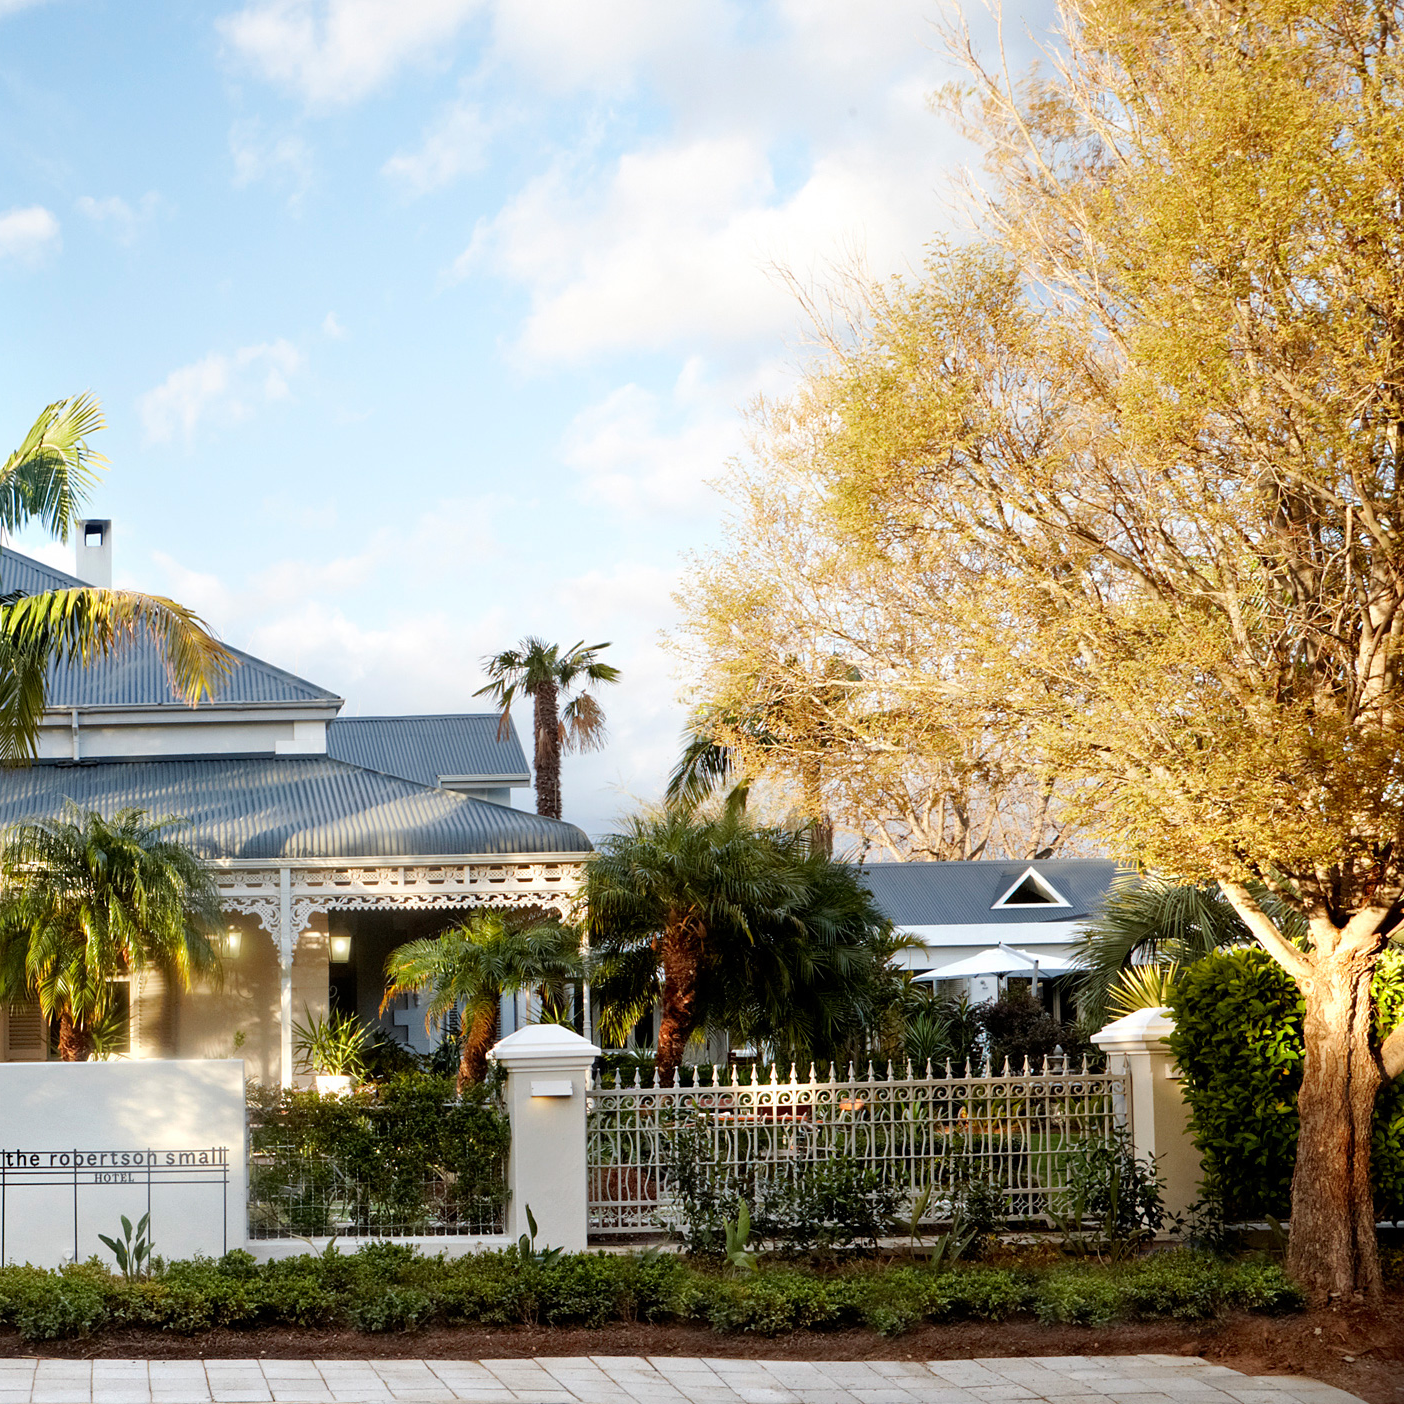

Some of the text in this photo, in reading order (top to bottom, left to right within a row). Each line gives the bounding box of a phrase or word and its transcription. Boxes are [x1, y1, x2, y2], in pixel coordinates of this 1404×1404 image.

[5, 1146, 223, 1167] the robertson small
[94, 1173, 135, 1183] HOTEL
